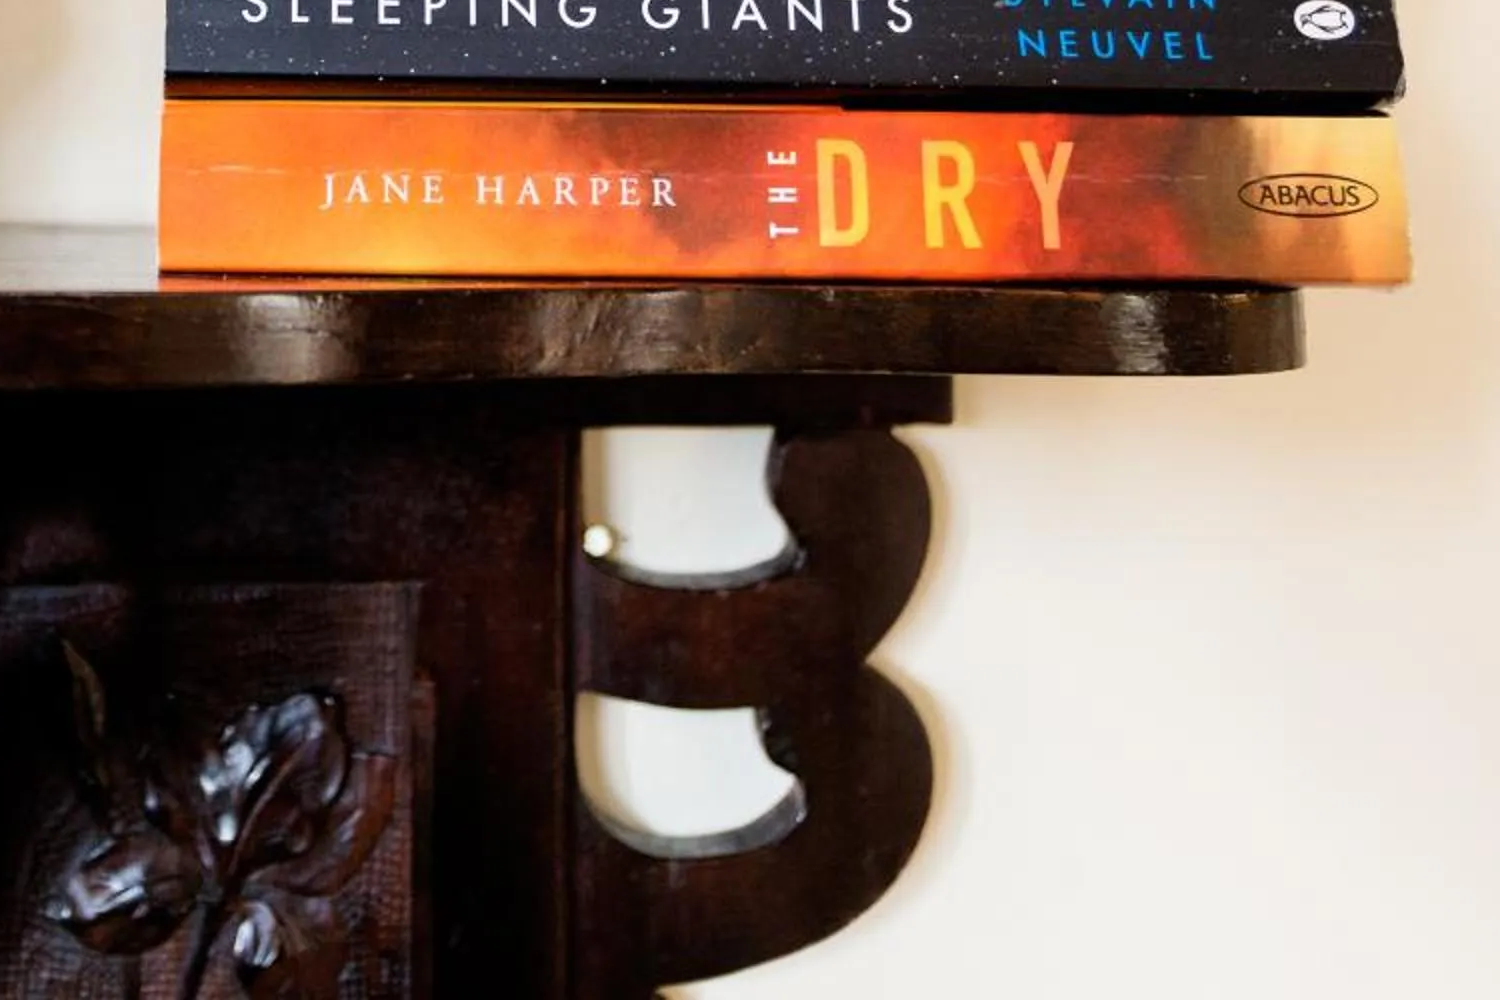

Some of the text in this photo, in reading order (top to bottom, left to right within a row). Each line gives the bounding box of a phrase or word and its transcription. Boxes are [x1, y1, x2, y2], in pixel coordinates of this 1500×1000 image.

[1017, 28, 1214, 61] NEUVEL
[319, 173, 677, 210] JANE HARPER
[766, 138, 1075, 250] THE DRY
[1259, 183, 1361, 208] ABACUS
